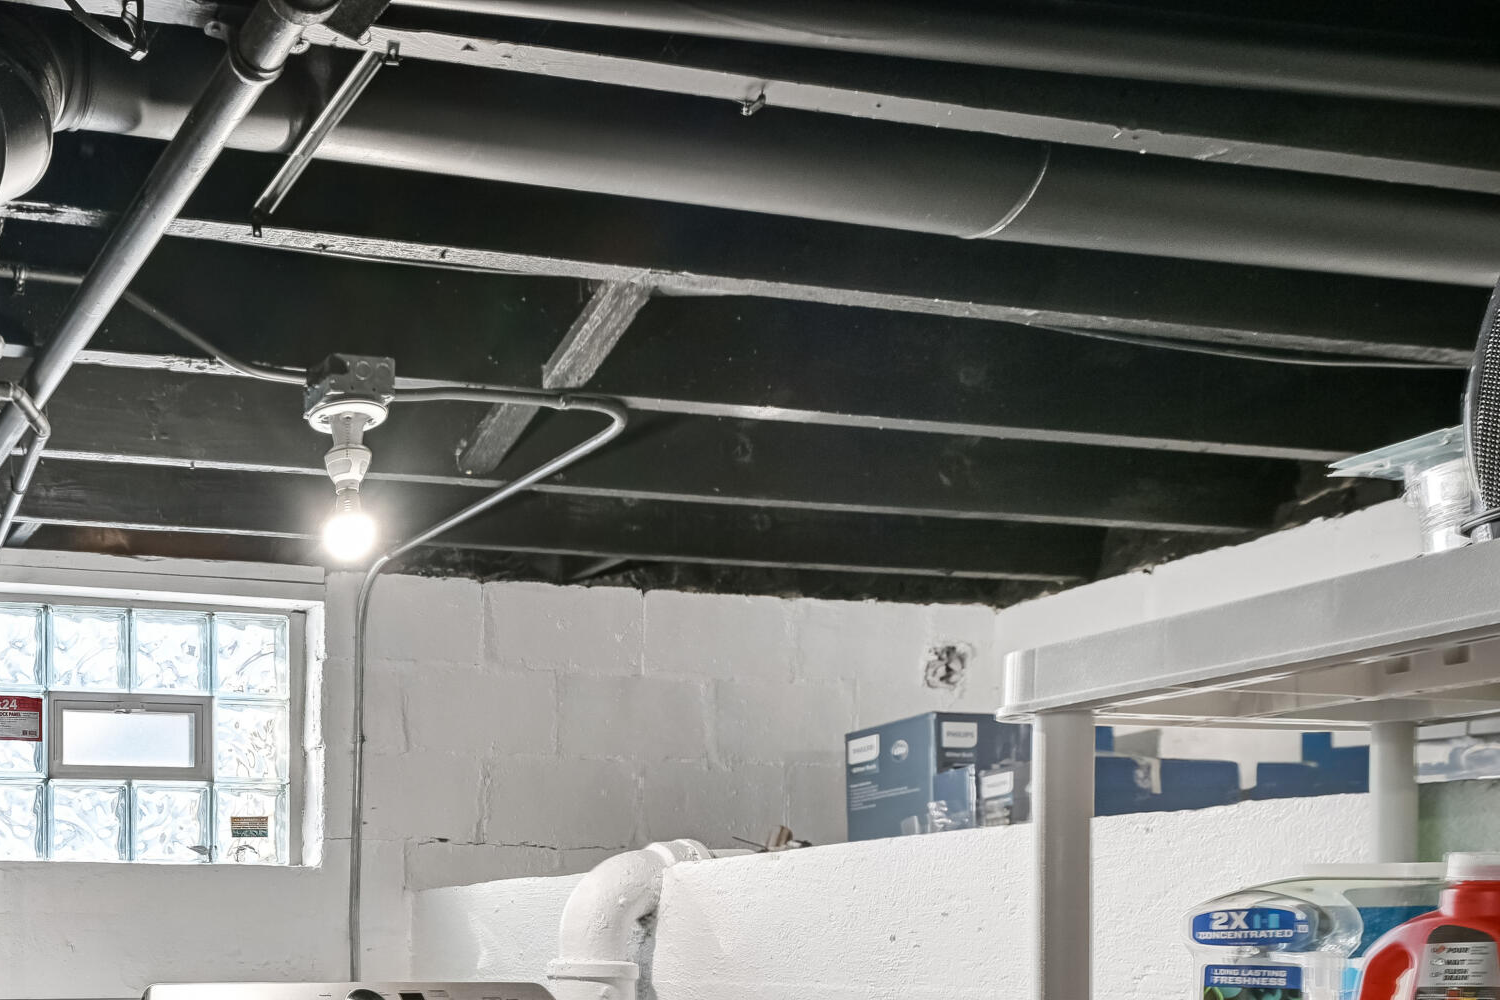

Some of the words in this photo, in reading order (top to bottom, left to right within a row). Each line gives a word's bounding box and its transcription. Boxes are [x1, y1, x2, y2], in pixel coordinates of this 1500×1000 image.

[1211, 911, 1250, 931] 2X
[1196, 929, 1294, 940] CONCENTRATED
[1241, 969, 1287, 977] LASTING
[1212, 976, 1287, 986] FRESHNESS
